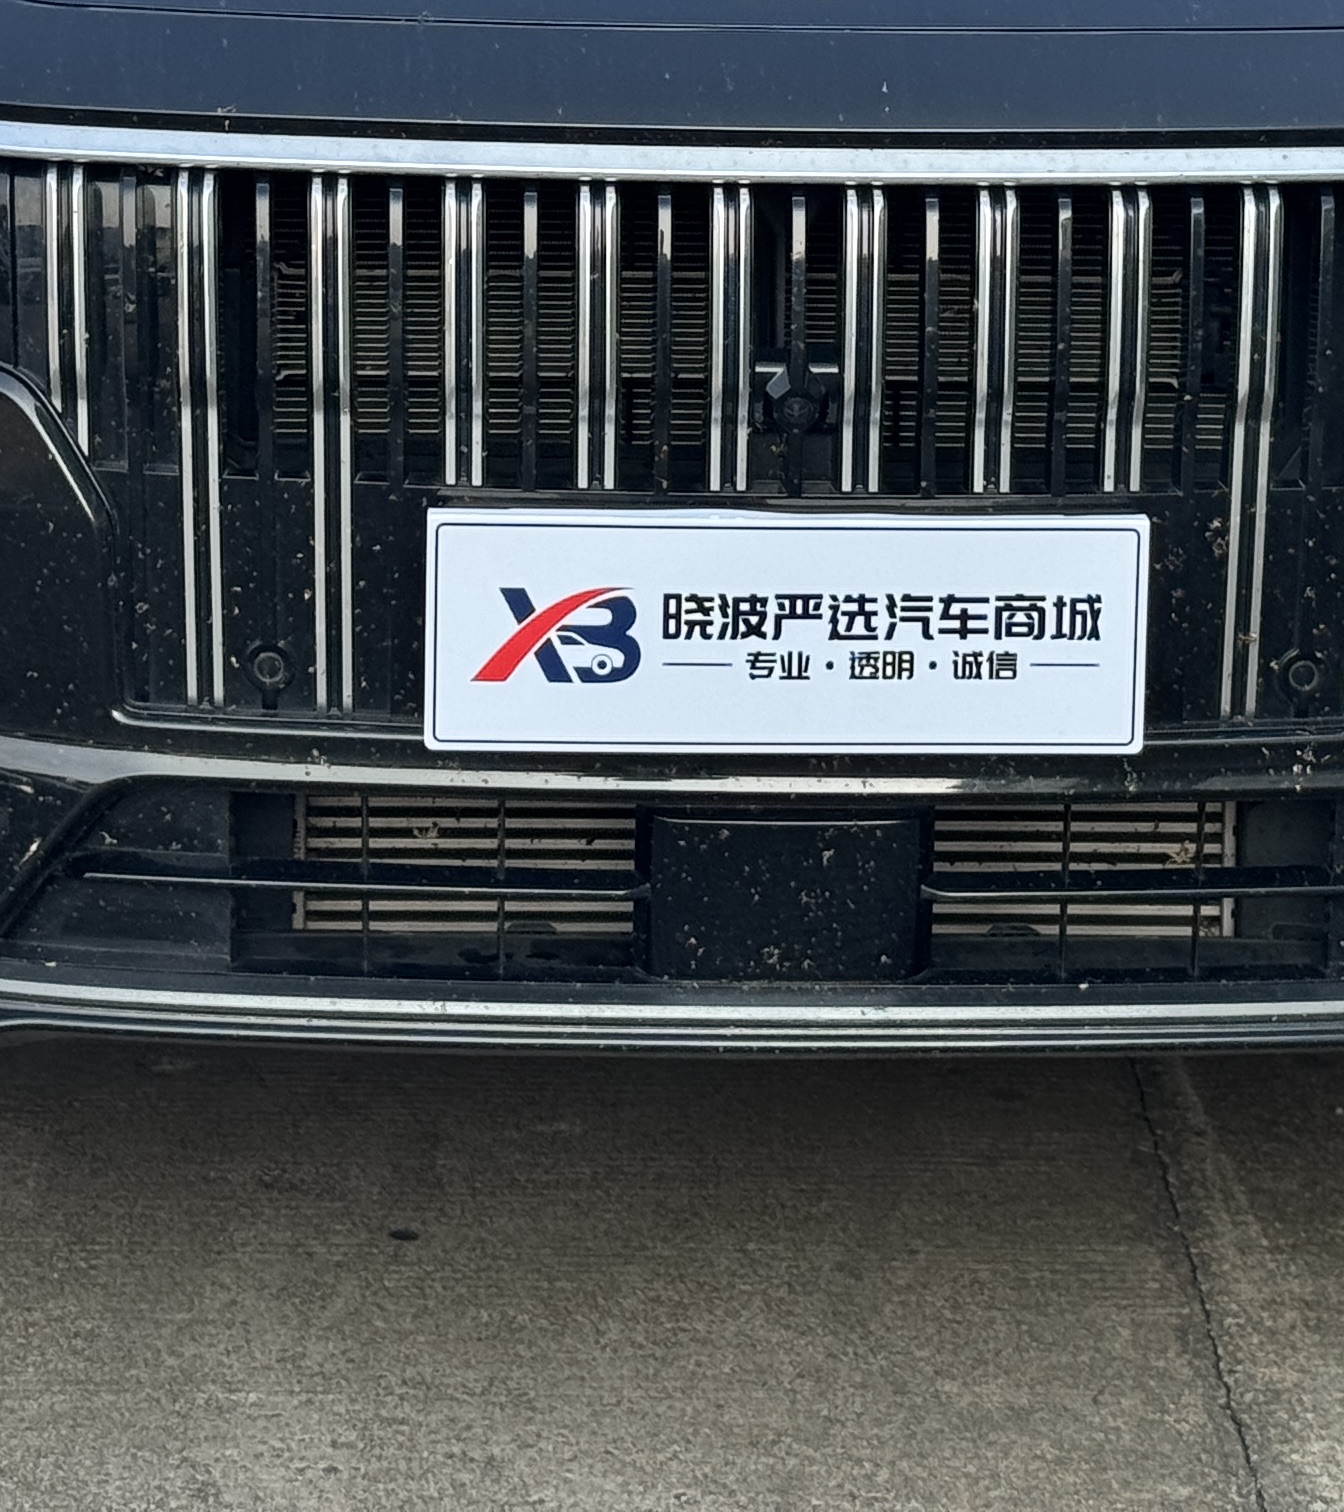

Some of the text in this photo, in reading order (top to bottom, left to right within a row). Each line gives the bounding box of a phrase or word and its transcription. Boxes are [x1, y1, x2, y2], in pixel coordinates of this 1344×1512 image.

[662, 593, 1103, 642] 晓波严选汽车商城
